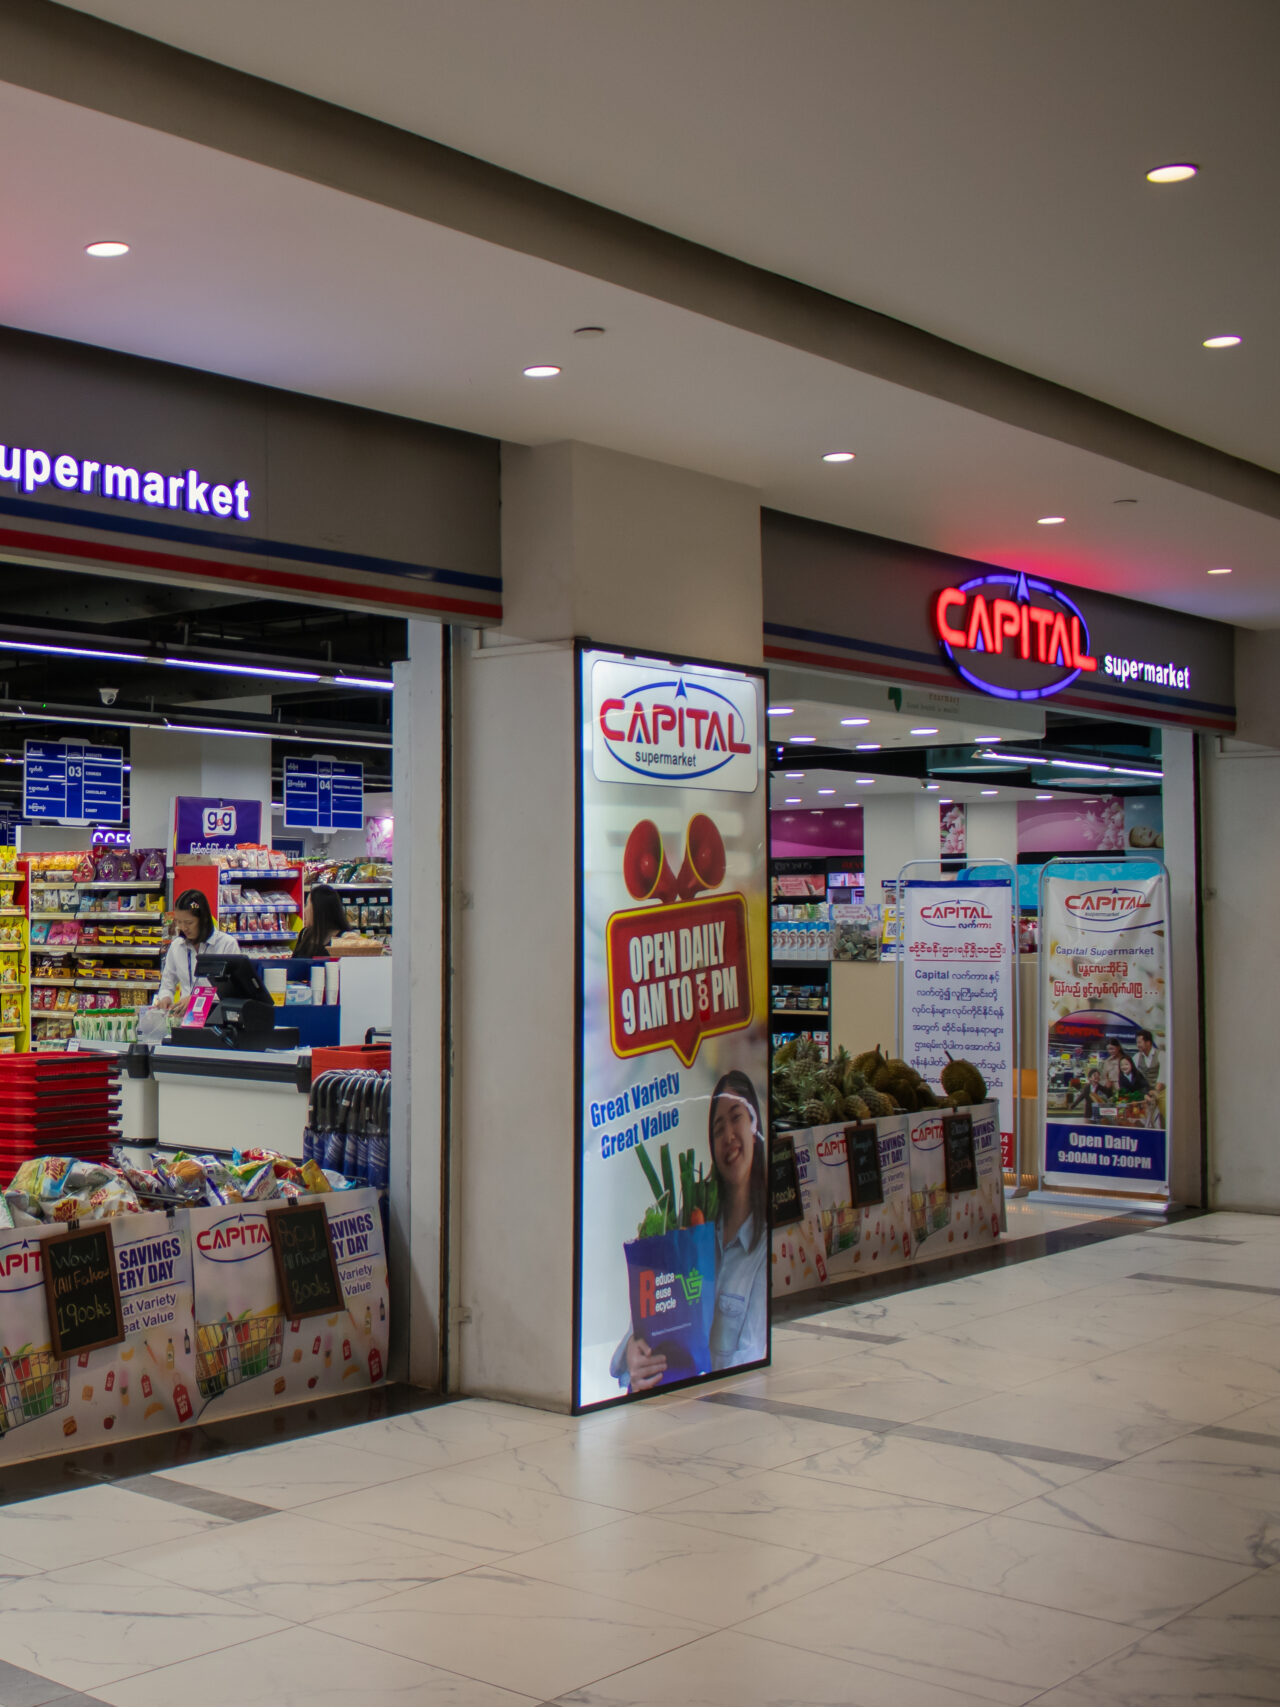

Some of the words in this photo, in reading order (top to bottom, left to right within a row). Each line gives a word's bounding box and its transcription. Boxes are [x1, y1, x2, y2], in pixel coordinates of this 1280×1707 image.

[934, 586, 1098, 672] CAPITAL
[1104, 653, 1192, 690] supermarket
[599, 698, 751, 755] CAPITAL
[635, 749, 697, 767] supermarket
[68, 765, 82, 778] 03
[319, 779, 331, 791] 04
[1065, 894, 1151, 911] CAPITAL
[920, 906, 993, 919] CAPITAL
[958, 919, 992, 929] လက်ကား
[628, 929, 676, 983] OPEN
[679, 920, 726, 974] DAILY
[1056, 945, 1088, 956] Capital
[1090, 946, 1154, 957] Supermarket
[915, 969, 950, 981] Capital
[951, 970, 988, 981] လက်ကား
[621, 987, 636, 1036] 9
[638, 981, 668, 1030] AM
[669, 974, 694, 1022] TO
[711, 966, 739, 1012] PM
[589, 1090, 630, 1128] Great
[631, 1071, 681, 1113] Variety
[600, 1123, 640, 1160] Great
[641, 1107, 680, 1140] Value
[911, 1124, 944, 1143] CAPITA
[973, 1120, 995, 1138] AVINGS
[816, 1139, 848, 1158] CAPIT
[981, 1134, 993, 1149] DAY
[1069, 1132, 1103, 1151] Open
[1105, 1134, 1138, 1153] Daily
[891, 1149, 904, 1165] DAY
[1057, 1149, 1097, 1167] 9:00AM
[1099, 1152, 1110, 1167] to
[1111, 1152, 1152, 1171] 7:00PM
[331, 1213, 374, 1241] AVINGS
[196, 1224, 271, 1251] CAPITA
[348, 1234, 369, 1255] DAY
[119, 1237, 182, 1270] SAVINGS
[119, 1267, 144, 1291] ERY
[148, 1259, 174, 1284] DAY
[338, 1264, 373, 1282] Variety
[344, 1281, 372, 1297] Value
[136, 1293, 177, 1313] Variety
[142, 1311, 175, 1328] Value
